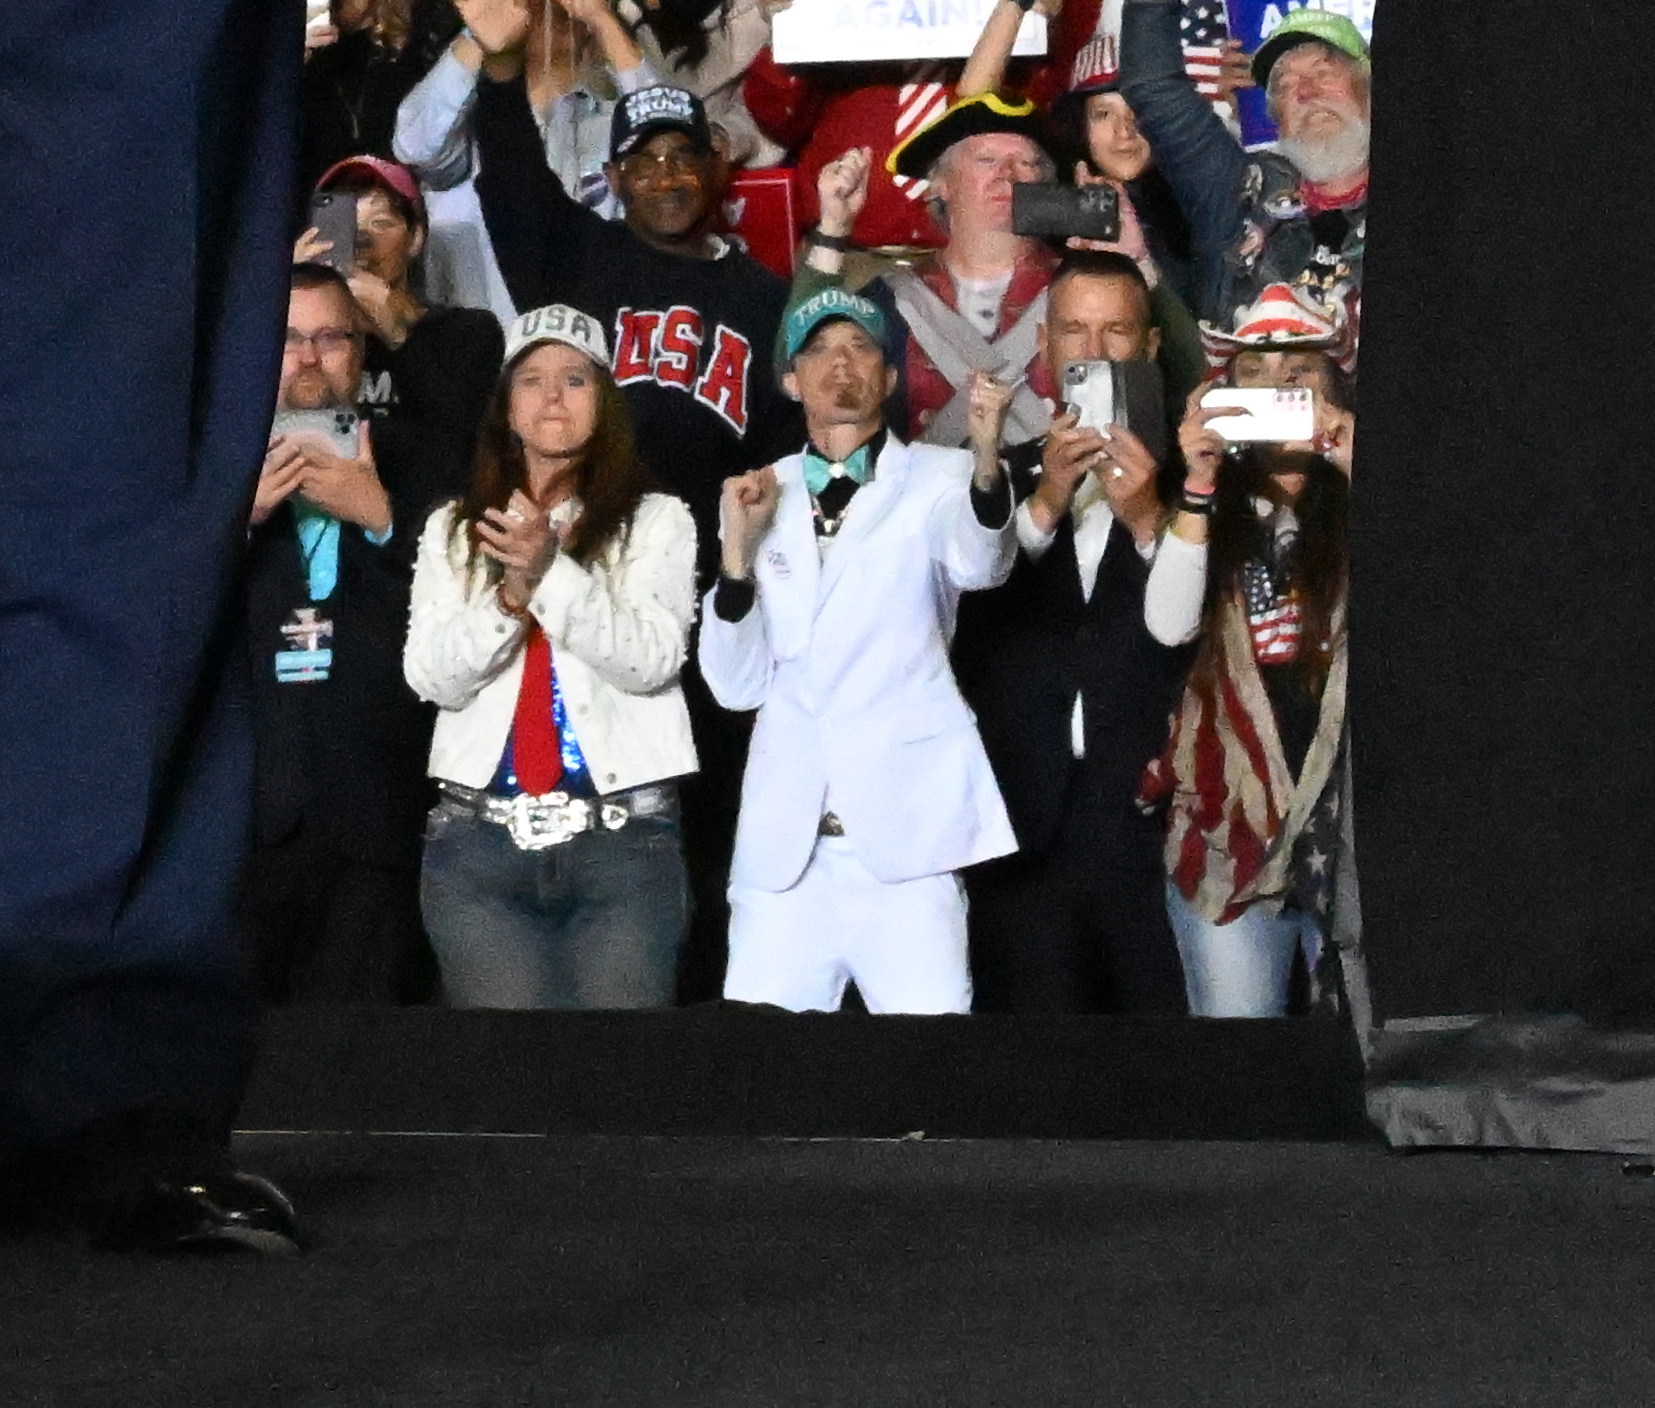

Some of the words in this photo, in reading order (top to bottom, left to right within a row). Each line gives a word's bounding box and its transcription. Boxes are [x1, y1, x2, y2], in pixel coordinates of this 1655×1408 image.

[521, 307, 592, 344] USA
[798, 290, 877, 330] TRUMP
[610, 304, 752, 439] USA
